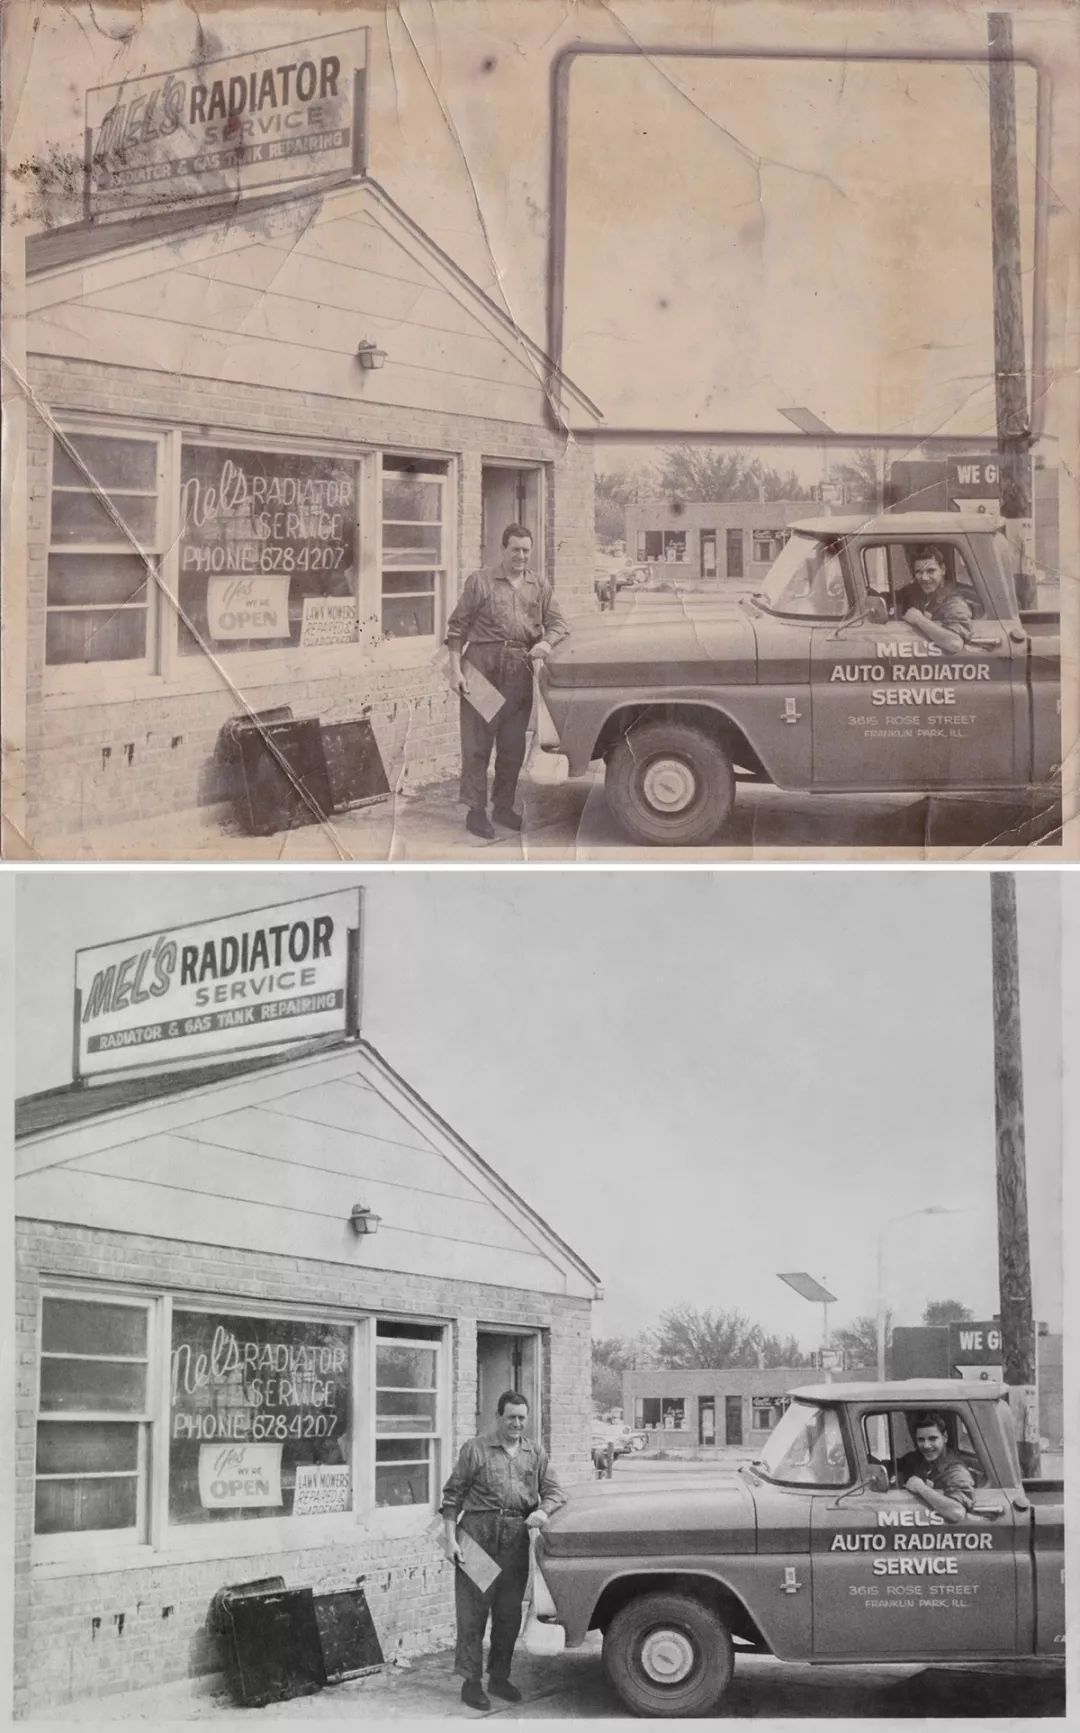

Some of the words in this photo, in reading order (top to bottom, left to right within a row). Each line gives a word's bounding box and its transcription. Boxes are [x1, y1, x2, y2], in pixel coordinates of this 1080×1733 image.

[190, 56, 340, 124] RADIATOR
[204, 106, 323, 145] SERVICE
[177, 160, 188, 176] &
[269, 131, 342, 158] REPAIRING
[957, 464, 980, 484] WE
[252, 476, 352, 506] RADIATOR
[258, 511, 342, 540] SERVICE
[181, 545, 253, 572] PHONE
[218, 610, 278, 632] OPEN
[877, 640, 943, 659] MEL'S
[830, 665, 886, 683] AUTO
[892, 664, 991, 681] RADIATOR
[872, 687, 956, 706] SERVICE
[885, 715, 921, 726] ROSE
[927, 715, 977, 725] STREET
[82, 935, 177, 1023] MEL'S
[181, 915, 334, 986] RADIATOR
[195, 967, 317, 1007] SERVICE
[100, 1026, 162, 1050] RADIATOR
[168, 1022, 179, 1037] &
[184, 1016, 211, 1034] GAS
[217, 1010, 254, 1028] TANK
[261, 992, 336, 1020] REPAIRING
[960, 1331, 983, 1350] WE
[245, 1342, 345, 1373] RADIATOR
[251, 1378, 336, 1408] SERVICE
[173, 1413, 247, 1440] PHONE
[210, 1479, 270, 1499] OPEN
[877, 1509, 945, 1528] MEL'S
[831, 1534, 887, 1551] AUTO
[894, 1533, 993, 1550] RADIATOR
[873, 1557, 959, 1576] SERVICE
[848, 1585, 880, 1596] 3615
[886, 1585, 922, 1596] ROSE
[929, 1584, 979, 1595] STREET
[865, 1599, 914, 1608] FRANKLIN
